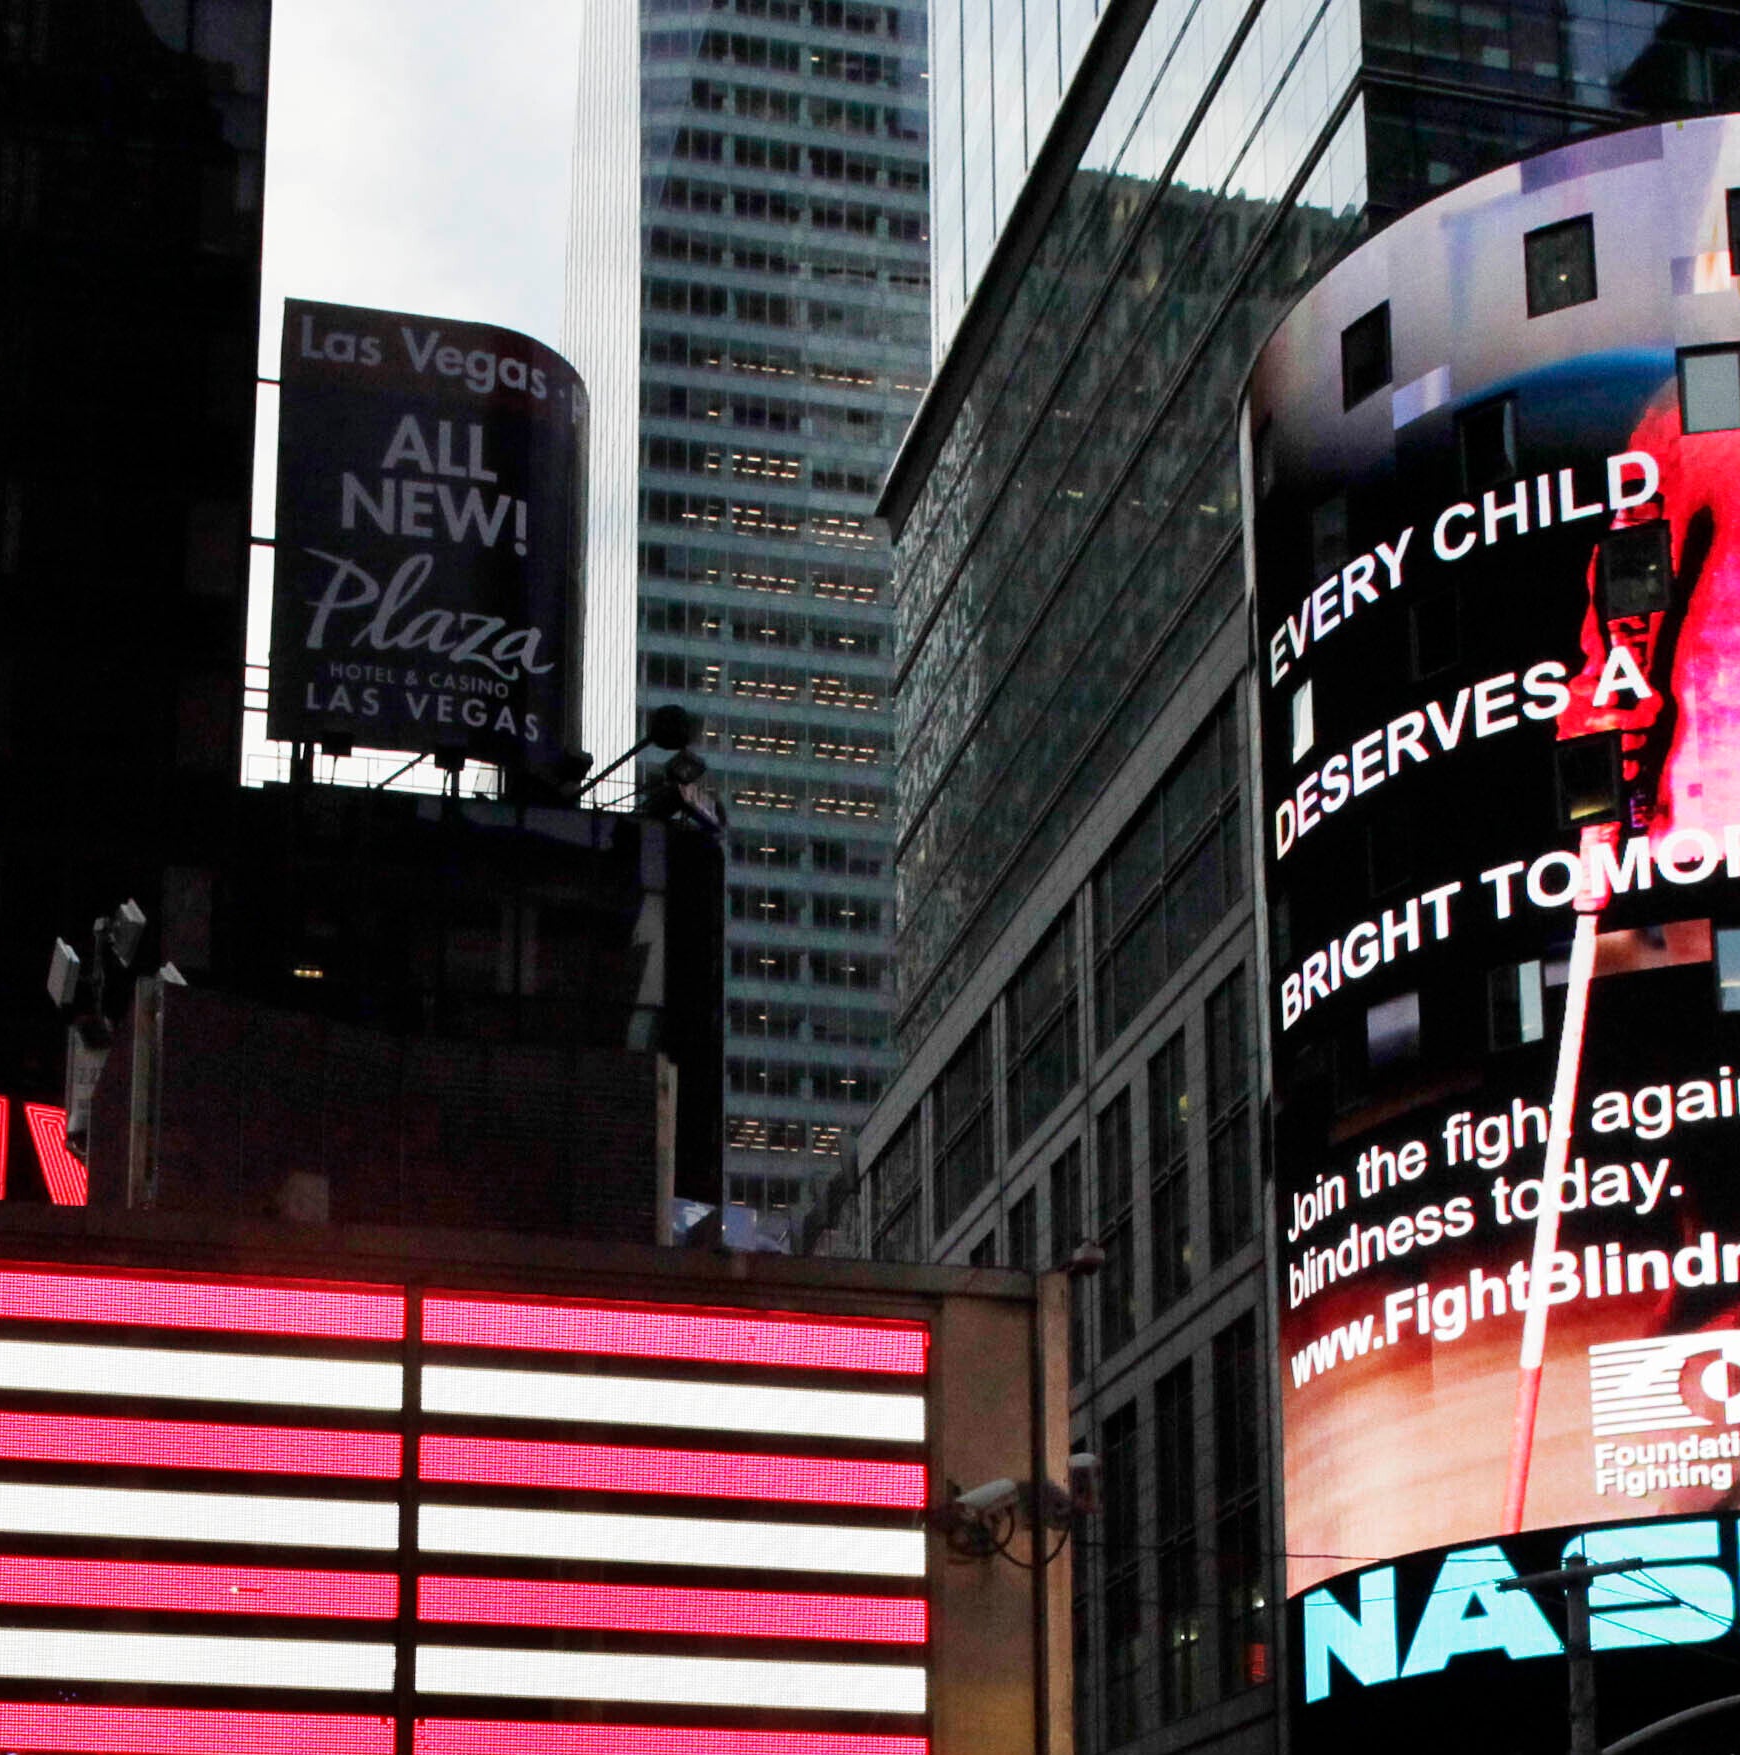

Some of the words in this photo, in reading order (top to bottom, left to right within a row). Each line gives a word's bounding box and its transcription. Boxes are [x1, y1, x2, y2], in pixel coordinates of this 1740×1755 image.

[301, 314, 382, 369] Las
[401, 326, 548, 398] Vegas
[380, 412, 498, 484] ALL
[341, 470, 528, 557] NEW!
[300, 546, 555, 682] Plaza
[1269, 526, 1416, 689] EVERY
[1432, 449, 1661, 562] CHILD
[306, 681, 380, 717] LAS
[404, 691, 540, 742] VEGAS
[329, 661, 397, 687] HOTEL
[404, 667, 420, 687] &
[428, 672, 510, 700] CASINO
[1275, 660, 1570, 861] DESERVES
[1592, 645, 1653, 709] A
[1281, 881, 1463, 1032] BRIGHT
[1287, 1170, 1347, 1242] Join
[1356, 1137, 1428, 1201] the
[1289, 1195, 1475, 1311] blindness
[1491, 1157, 1684, 1226] today.
[1595, 1460, 1733, 1498] Fighting
